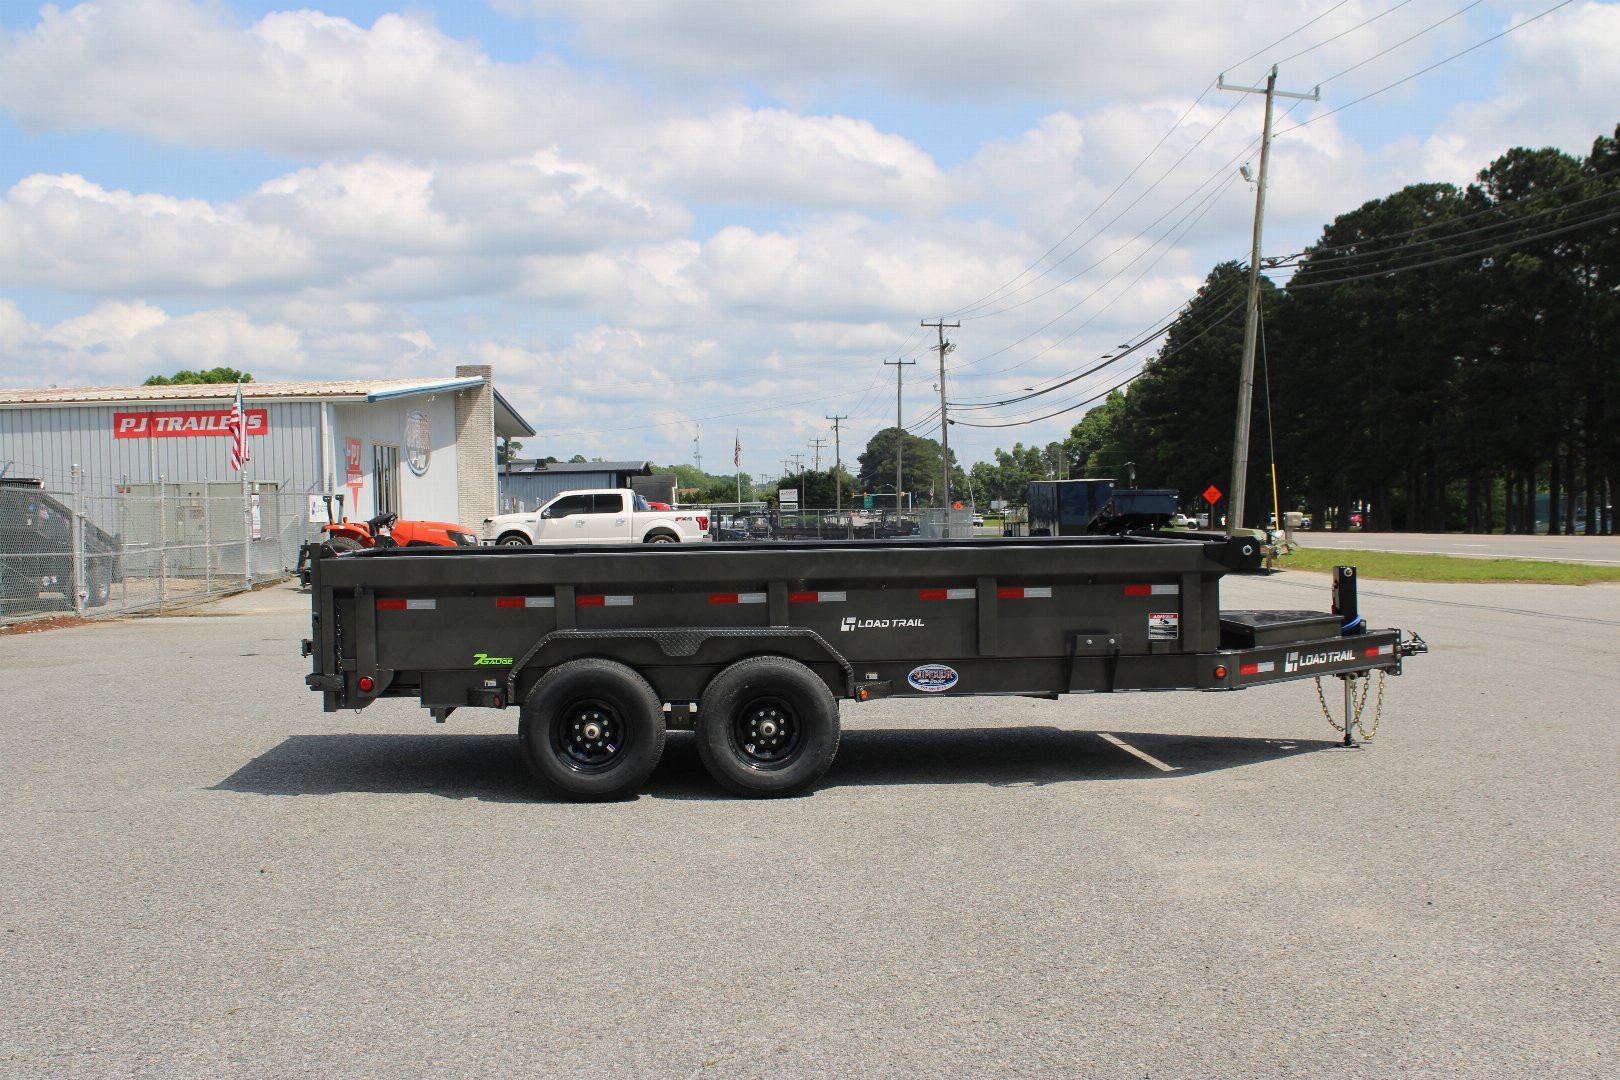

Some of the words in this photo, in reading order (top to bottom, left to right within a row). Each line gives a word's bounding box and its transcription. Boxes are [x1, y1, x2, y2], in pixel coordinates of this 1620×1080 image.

[119, 418, 148, 432] PJ
[156, 415, 262, 432] TRAILES
[858, 619, 889, 628] LOAD
[892, 618, 925, 628] TRAIL
[473, 653, 488, 666] 7
[1299, 653, 1326, 667] LOAD
[1328, 650, 1355, 663] TRAIL
